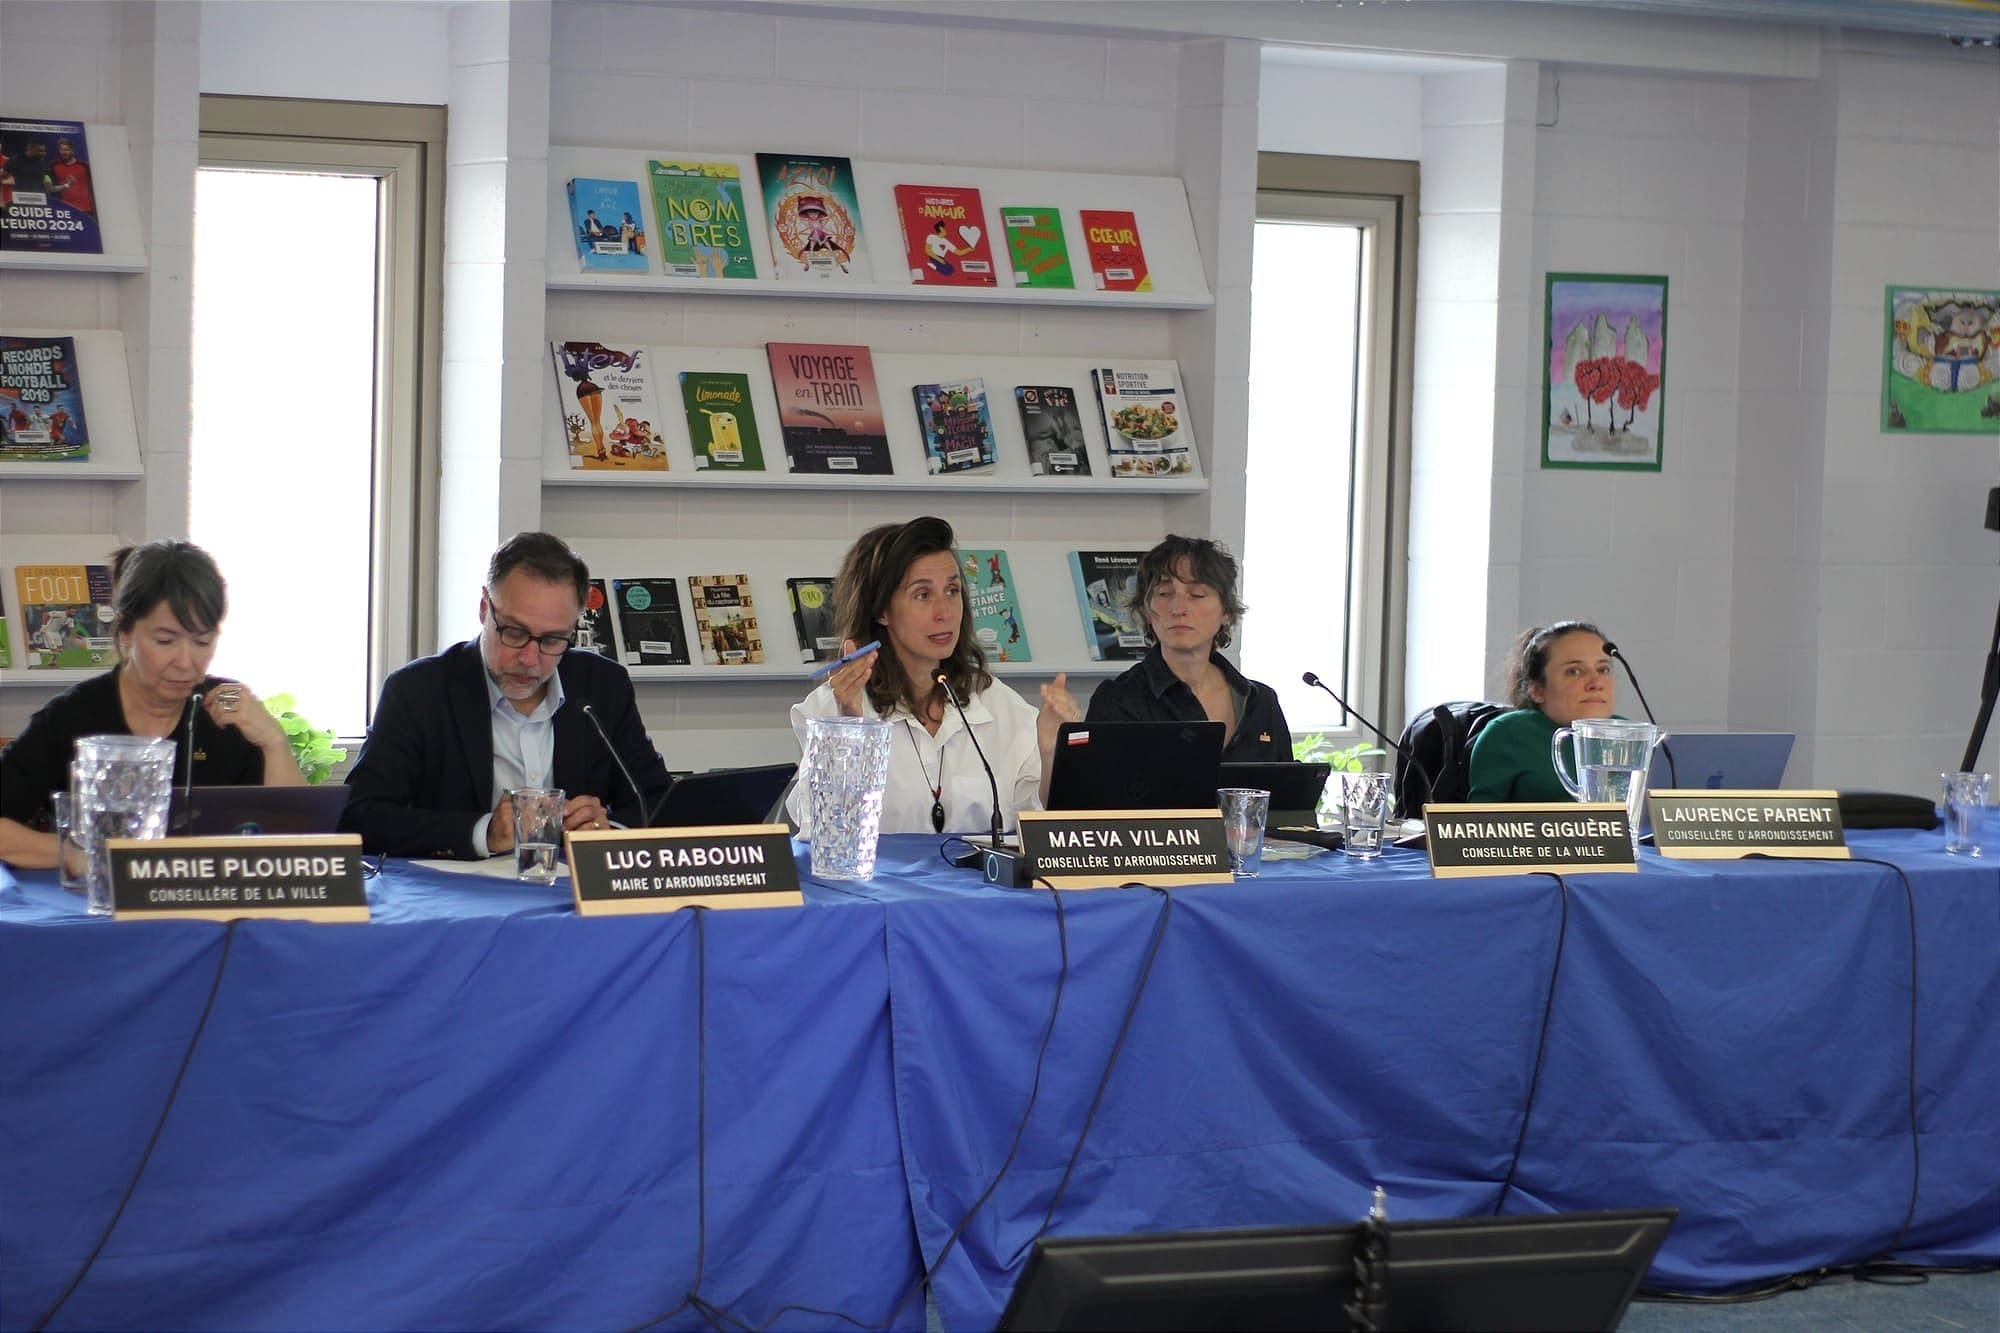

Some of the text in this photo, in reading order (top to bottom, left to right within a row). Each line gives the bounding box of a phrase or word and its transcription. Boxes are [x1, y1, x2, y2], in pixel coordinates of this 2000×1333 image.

[9, 206, 71, 219] GUIDE DE
[665, 196, 740, 222] NOM
[1, 218, 84, 231] L'EURO 2024
[671, 223, 742, 248] BRES
[3, 345, 63, 364] RECORDS
[8, 362, 53, 376] MONDE
[789, 354, 858, 381] VOYAGE
[2, 375, 67, 389] FOOTBALL
[21, 388, 50, 402] 2019
[795, 382, 863, 406] en TRAIN
[25, 576, 82, 601] FOOT
[970, 592, 1007, 608] FIANCE
[981, 605, 998, 616] TOI
[1661, 807, 1833, 823] LAURENCE PARENT
[1437, 817, 1624, 839] MARIANNE GIGUÈRE
[1667, 828, 1834, 841] CONSEILLÈRE D'ARRONDISSEMENT
[1048, 828, 1202, 848] MAEVA VILAIN
[606, 845, 765, 870] LUC RABOUIN
[1462, 844, 1605, 859] CONSEILLÈRE DE LA VILLE
[130, 856, 347, 880] MARIE PLOURDE
[1037, 853, 1218, 870] CONSEILLÈRE D'ARRONDISSEMENT
[612, 872, 767, 892] MAIRE D'ARRONDISSEMENT
[149, 885, 328, 902] CONSEILLÈRE DE LA VILLE
